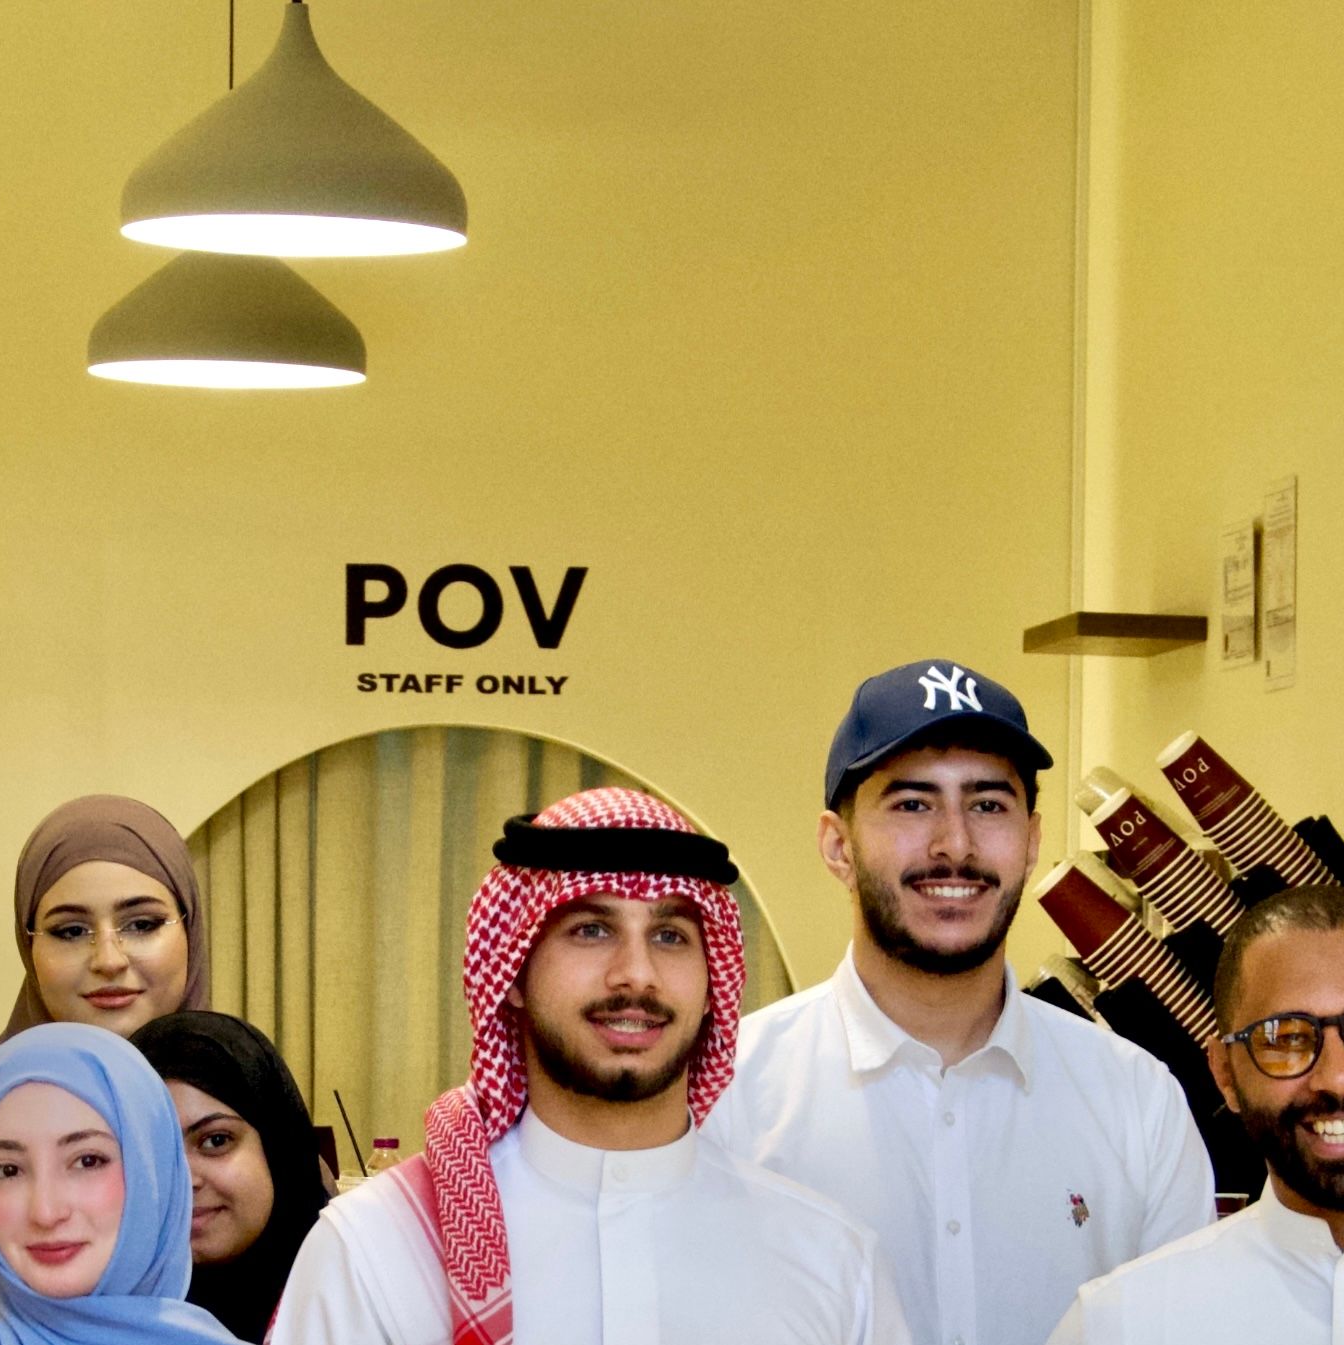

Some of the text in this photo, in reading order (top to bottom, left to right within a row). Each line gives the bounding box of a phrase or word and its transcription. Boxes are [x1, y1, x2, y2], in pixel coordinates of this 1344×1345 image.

[345, 562, 589, 650] POV
[356, 672, 569, 695] STAFF ONLY
[918, 665, 984, 713] NY
[1173, 757, 1210, 791] POV
[1109, 810, 1147, 847] POV
